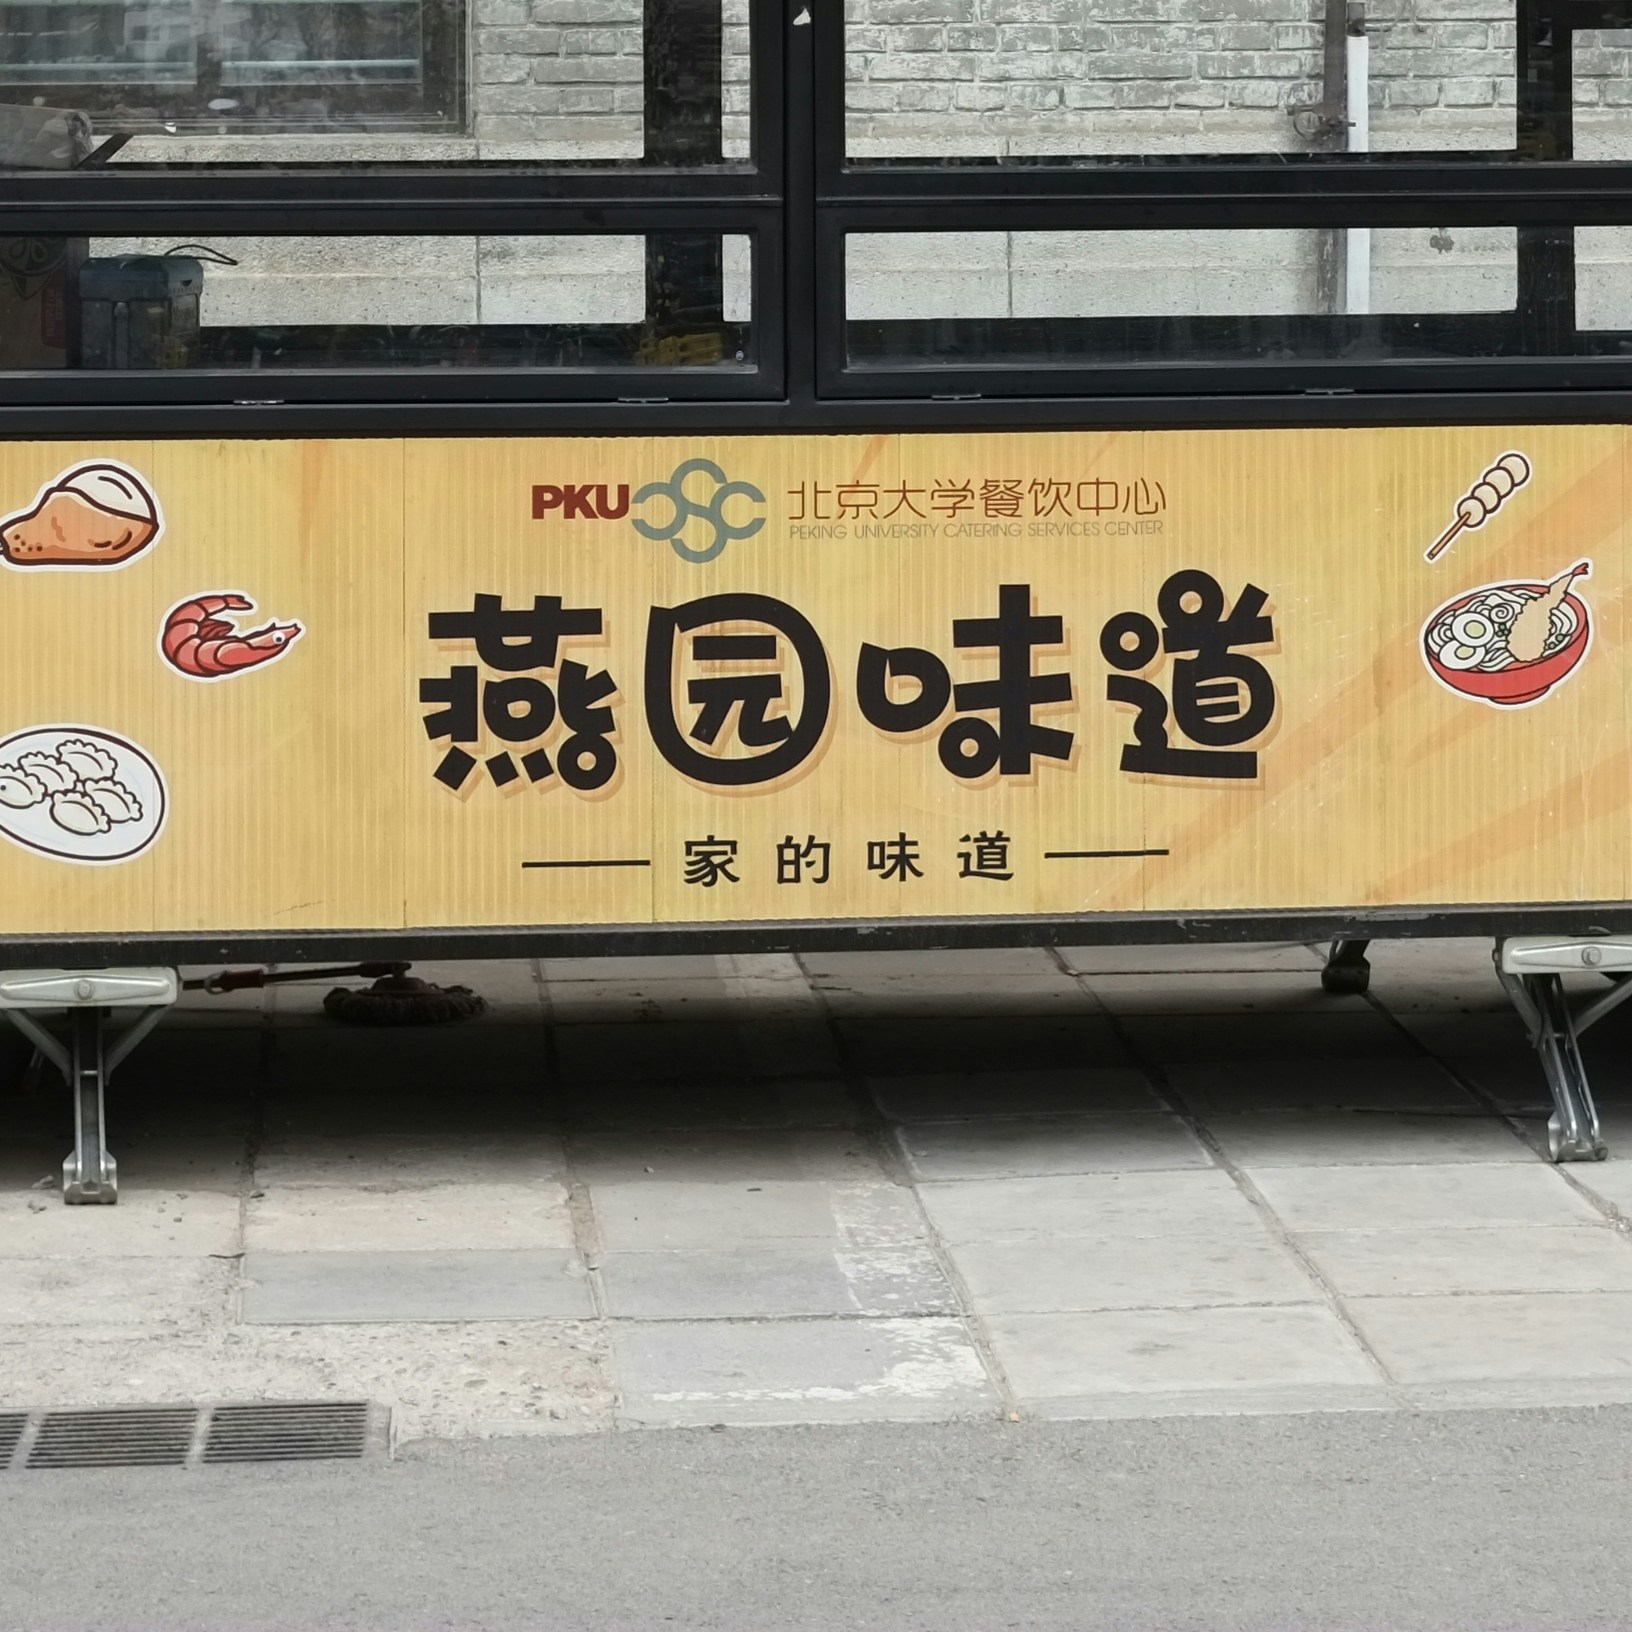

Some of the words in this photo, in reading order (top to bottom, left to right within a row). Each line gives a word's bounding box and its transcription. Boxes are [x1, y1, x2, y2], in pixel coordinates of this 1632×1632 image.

[532, 484, 630, 520] PKU
[787, 477, 1167, 520] 北京大学餐饮中心
[789, 524, 848, 540] PEKING
[854, 523, 940, 539] UNIVERSITY
[943, 522, 1023, 538] CATERING
[1027, 521, 1101, 537] SERVICES
[1104, 520, 1164, 536] CENTER
[419, 569, 1276, 792] 燕园味道
[684, 831, 1015, 888] 家的味道
